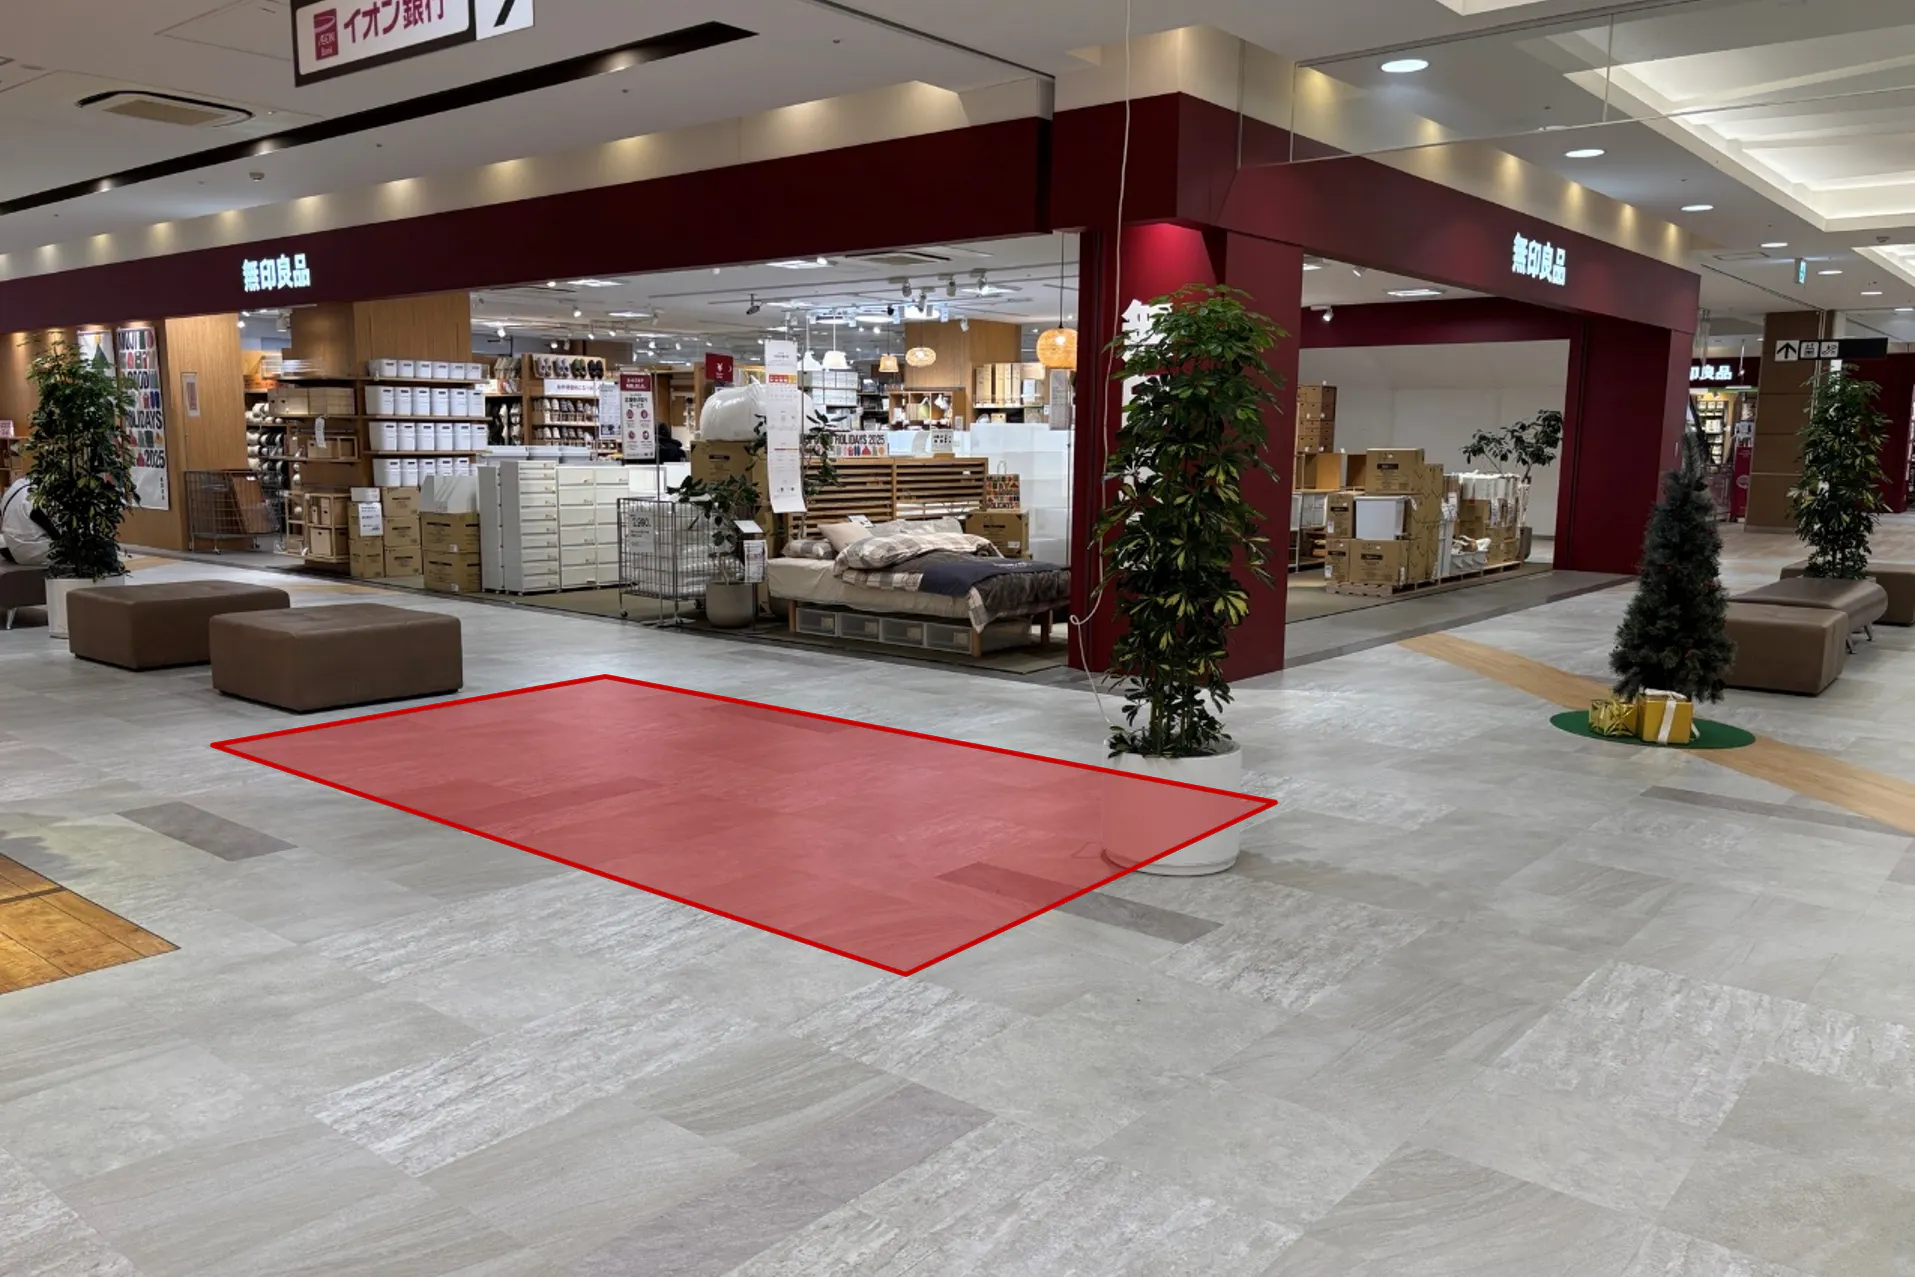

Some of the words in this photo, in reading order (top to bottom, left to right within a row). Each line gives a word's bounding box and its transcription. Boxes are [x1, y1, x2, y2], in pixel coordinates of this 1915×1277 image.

[343, 0, 445, 43] イオン銀行
[242, 253, 311, 292] 無印良品
[1511, 231, 1566, 286] 無印良品
[144, 449, 165, 468] 2025
[869, 434, 885, 445] 2025
